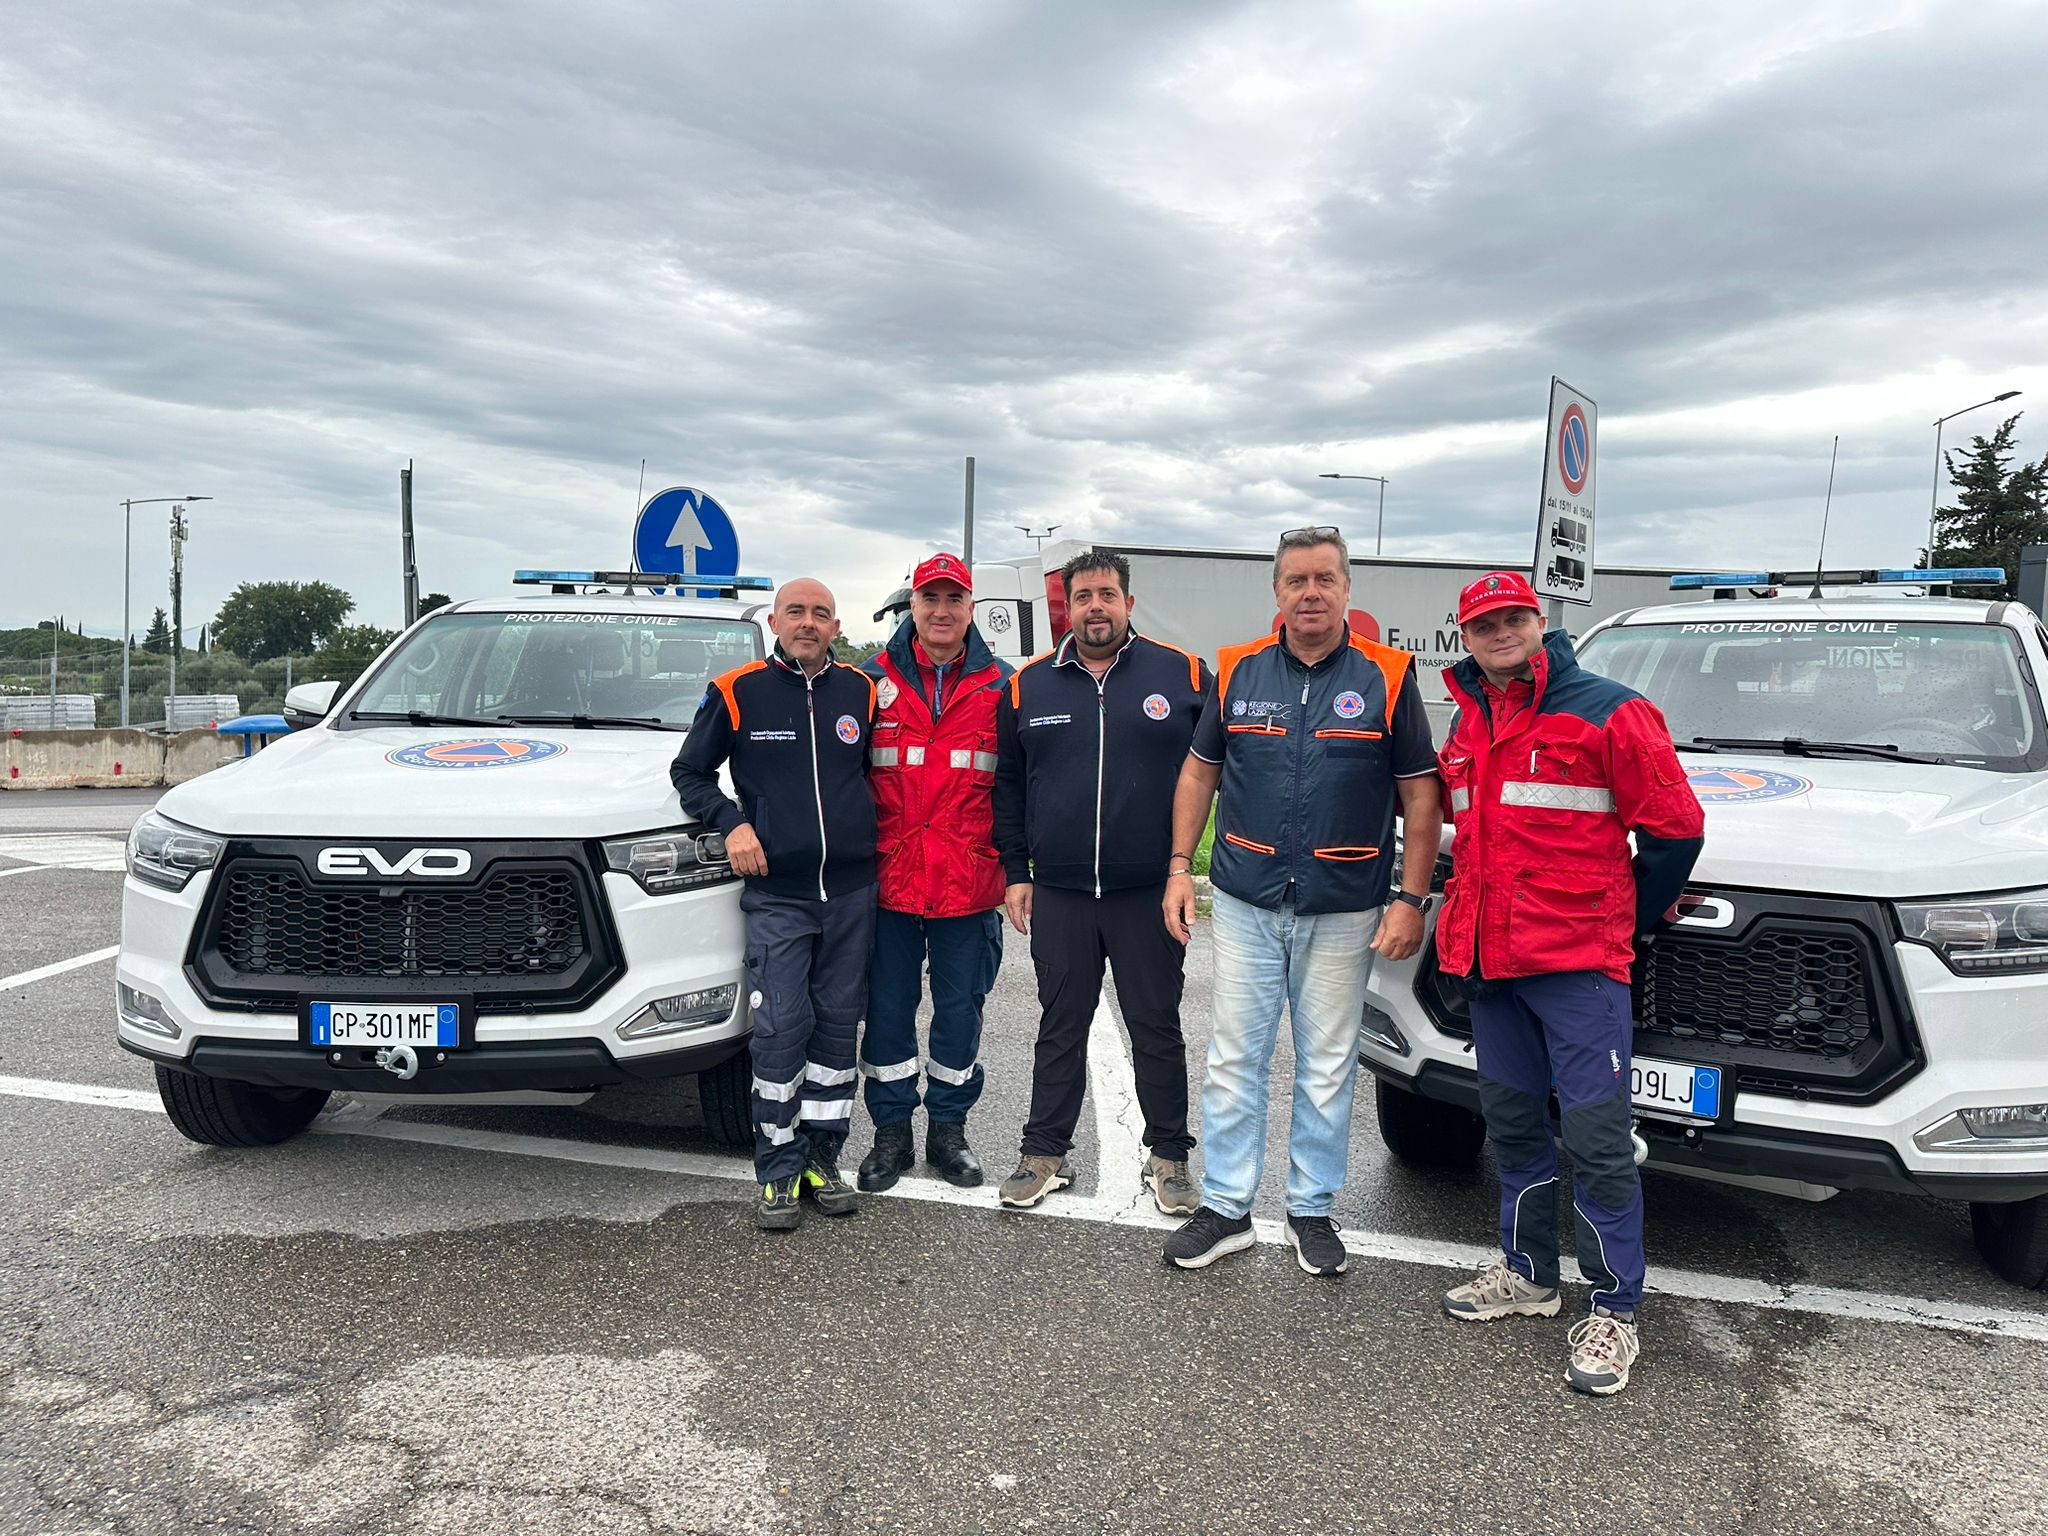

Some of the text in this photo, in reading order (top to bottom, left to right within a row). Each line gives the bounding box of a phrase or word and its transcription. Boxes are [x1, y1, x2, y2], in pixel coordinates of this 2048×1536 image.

[1547, 496, 1557, 509] dal
[1573, 504, 1579, 516] al
[503, 613, 680, 626] PROTEZIONE CIVILE
[1681, 622, 1899, 634] PROTEZIONE CIVILE
[473, 755, 533, 767] LAZIO
[1712, 789, 1777, 800] LAZIO
[317, 847, 472, 876] EVO
[1631, 1067, 1694, 1104] 09LJ
